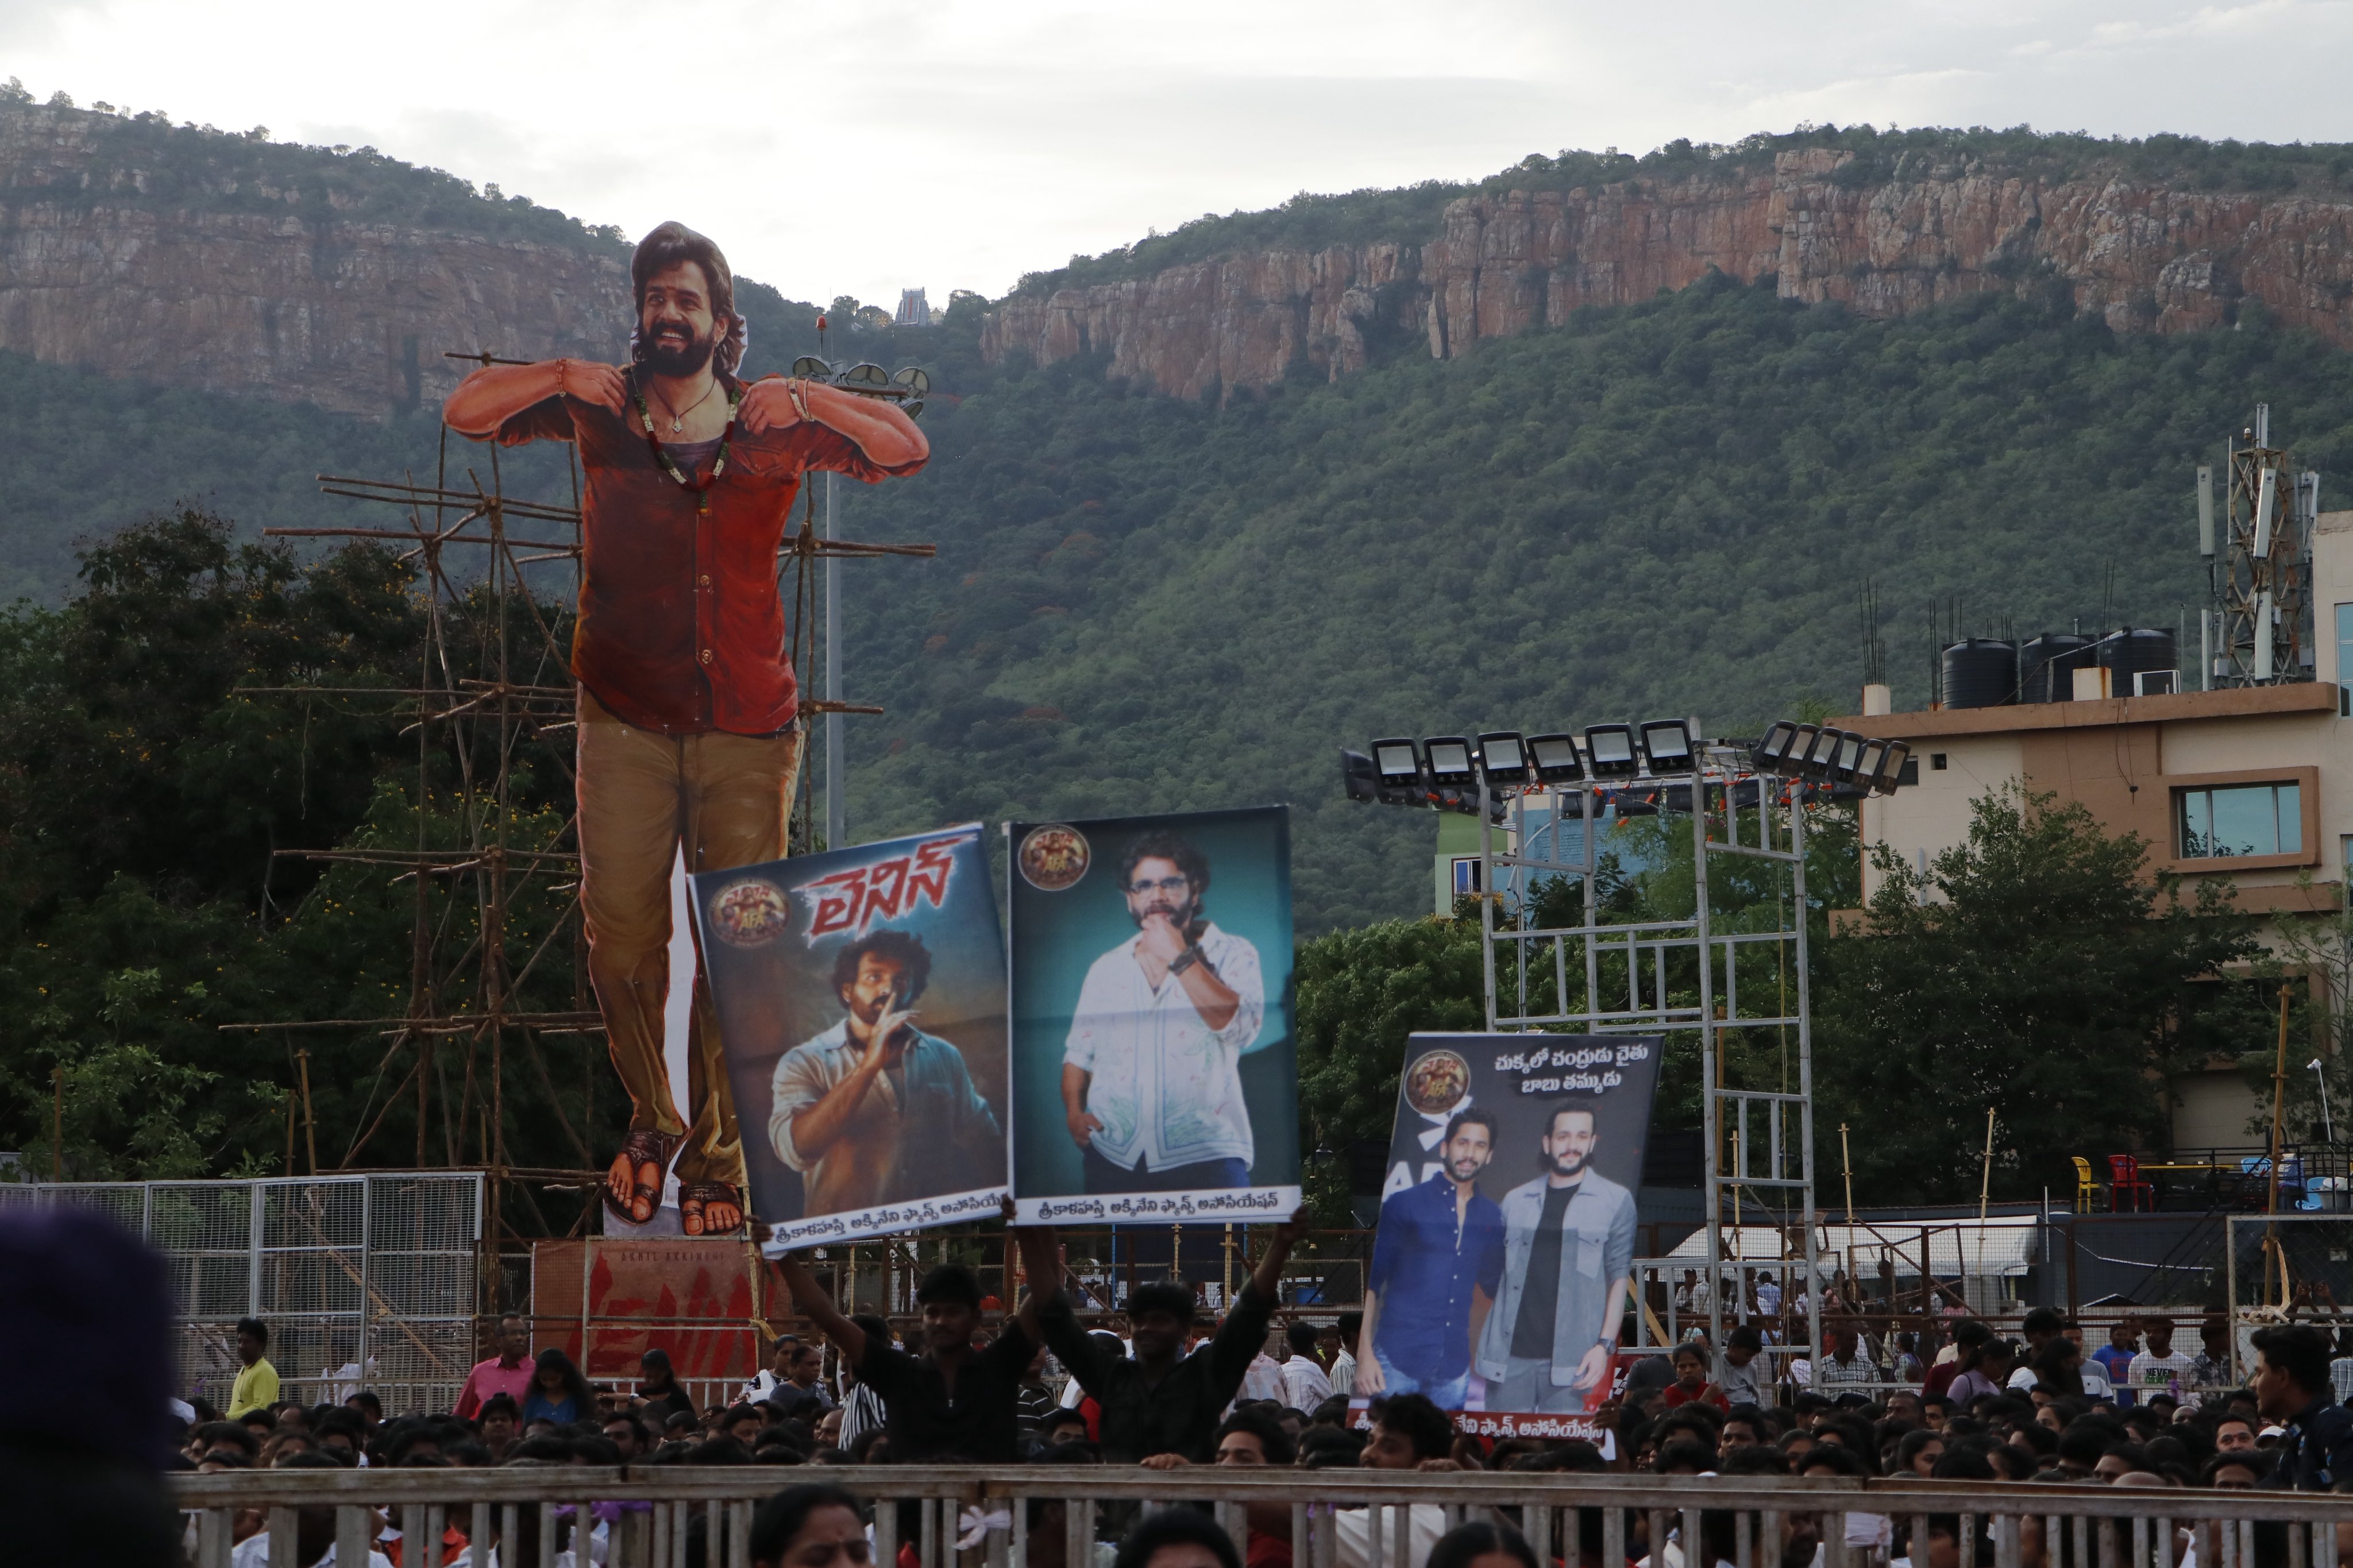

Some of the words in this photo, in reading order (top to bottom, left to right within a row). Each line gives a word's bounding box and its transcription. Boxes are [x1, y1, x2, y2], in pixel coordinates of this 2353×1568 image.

[1616, 1044, 1648, 1067] చైతు
[1521, 1077, 1560, 1094] బాబు
[1563, 1071, 1622, 1094] తమ్ముడు
[1039, 1200, 1105, 1219] శ్రీకాళహస్తి
[1110, 1198, 1158, 1217] అక్కినేని
[1160, 1196, 1195, 1215] ఫ్యాన్స్
[1198, 1192, 1279, 1211] అసోసియేషన్
[776, 1221, 846, 1243] శ్రీకాళహస్తి
[850, 1210, 900, 1230] అక్కినేని
[903, 1202, 939, 1221] ఫ్యాన్స్
